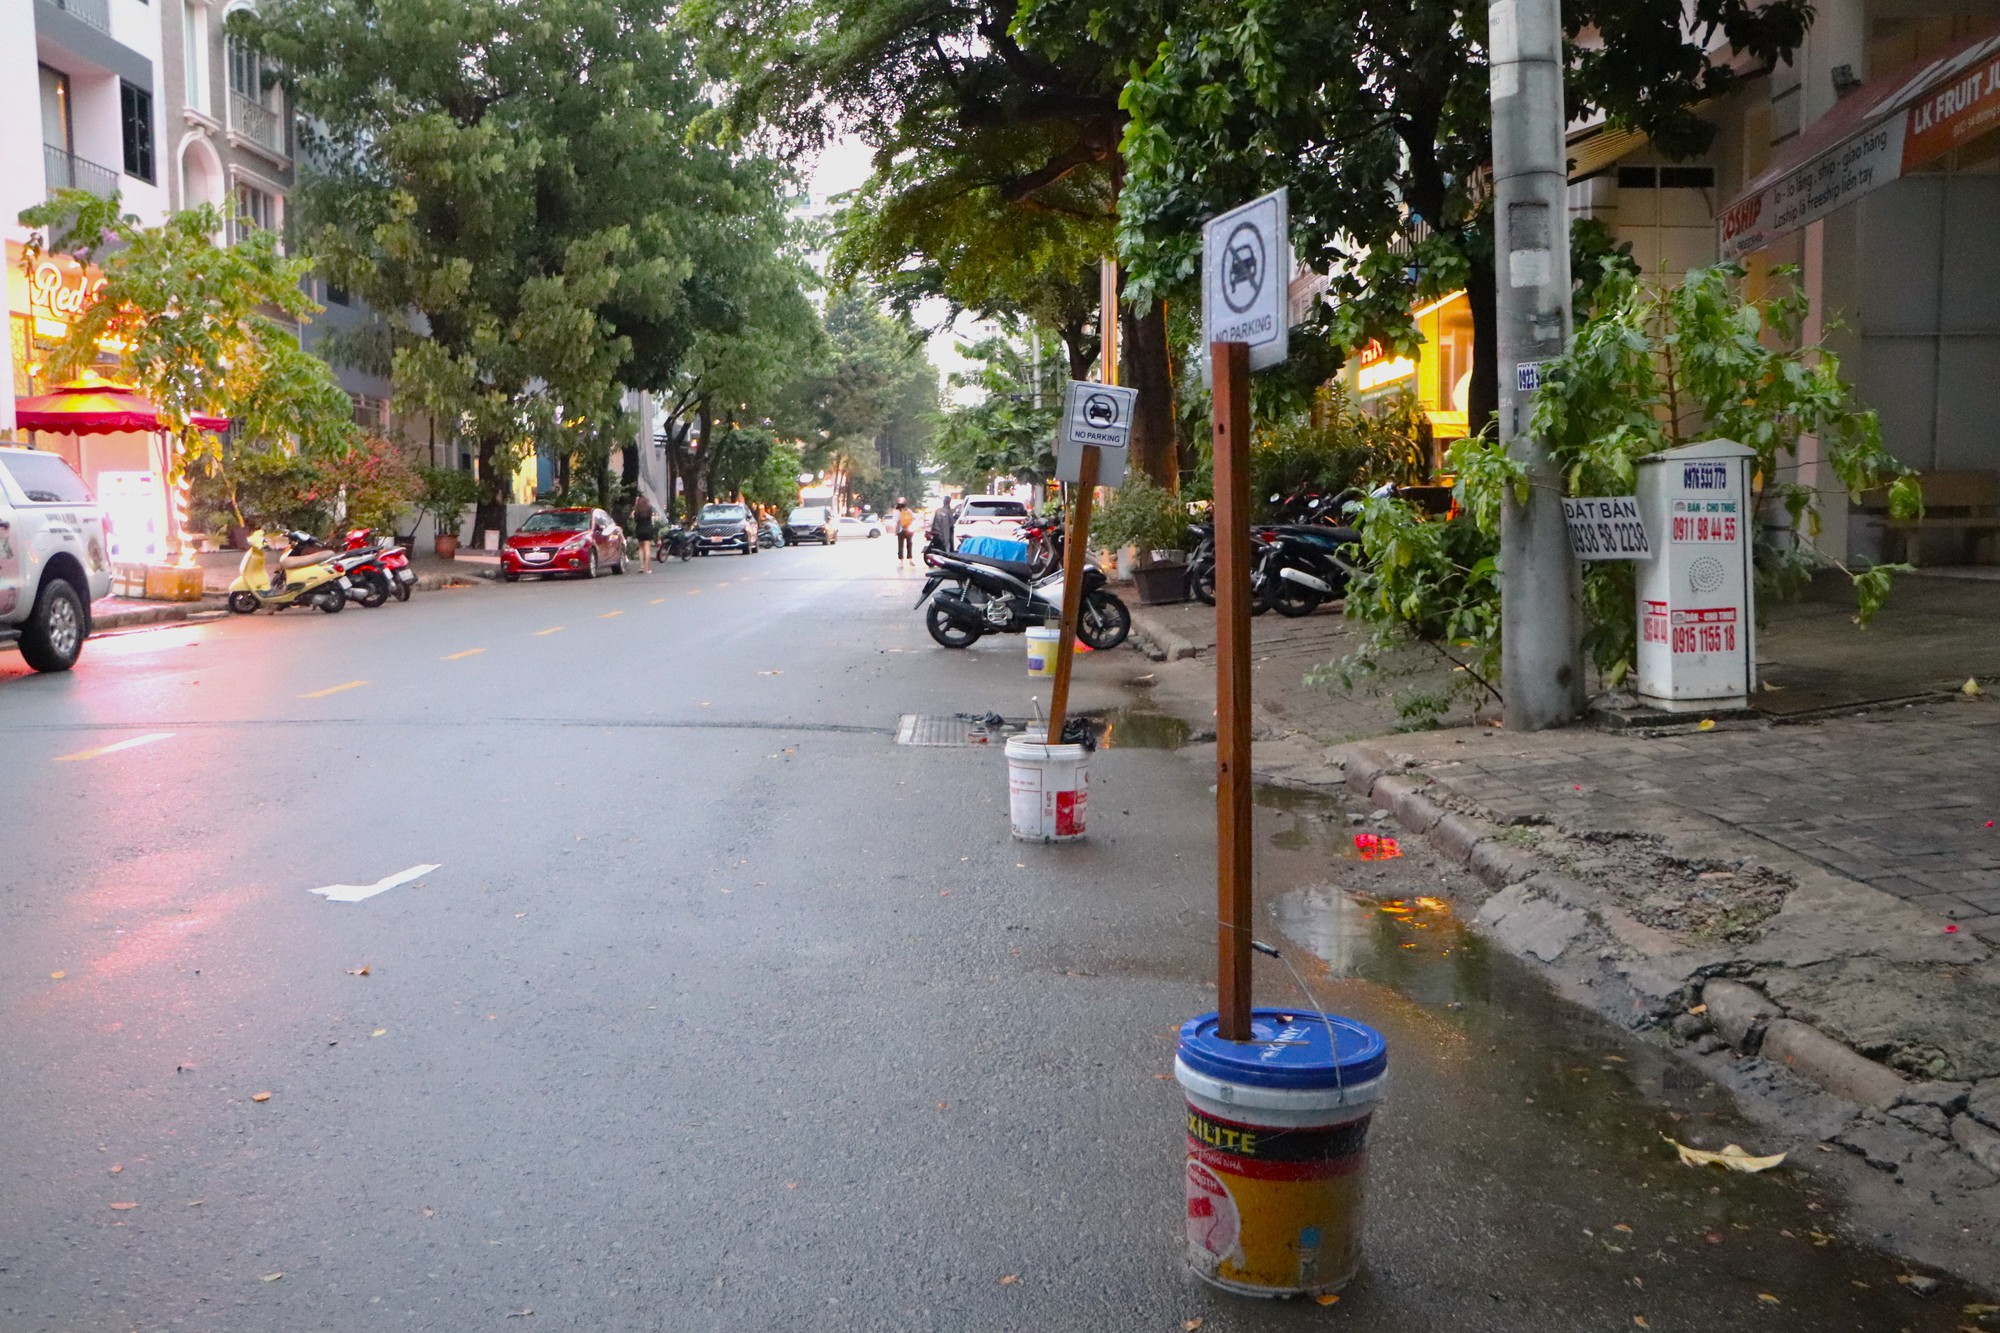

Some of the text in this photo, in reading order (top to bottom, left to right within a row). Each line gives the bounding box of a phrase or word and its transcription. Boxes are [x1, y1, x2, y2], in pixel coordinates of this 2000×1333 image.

[1914, 101, 1932, 135] LK
[1935, 71, 1983, 123] FRUIT
[1843, 145, 1862, 172] giao
[31, 262, 88, 317] Red
[1215, 314, 1272, 342] NO PARKING
[1075, 430, 1120, 443] NO PARKING
[1600, 498, 1637, 518] BÁN
[1568, 521, 1649, 553] 0938 58 2238
[1673, 517, 1736, 541] 0911 98 44 55
[1673, 626, 1696, 653] 0915
[1699, 625, 1721, 652] 1155
[1724, 624, 1736, 651] 18
